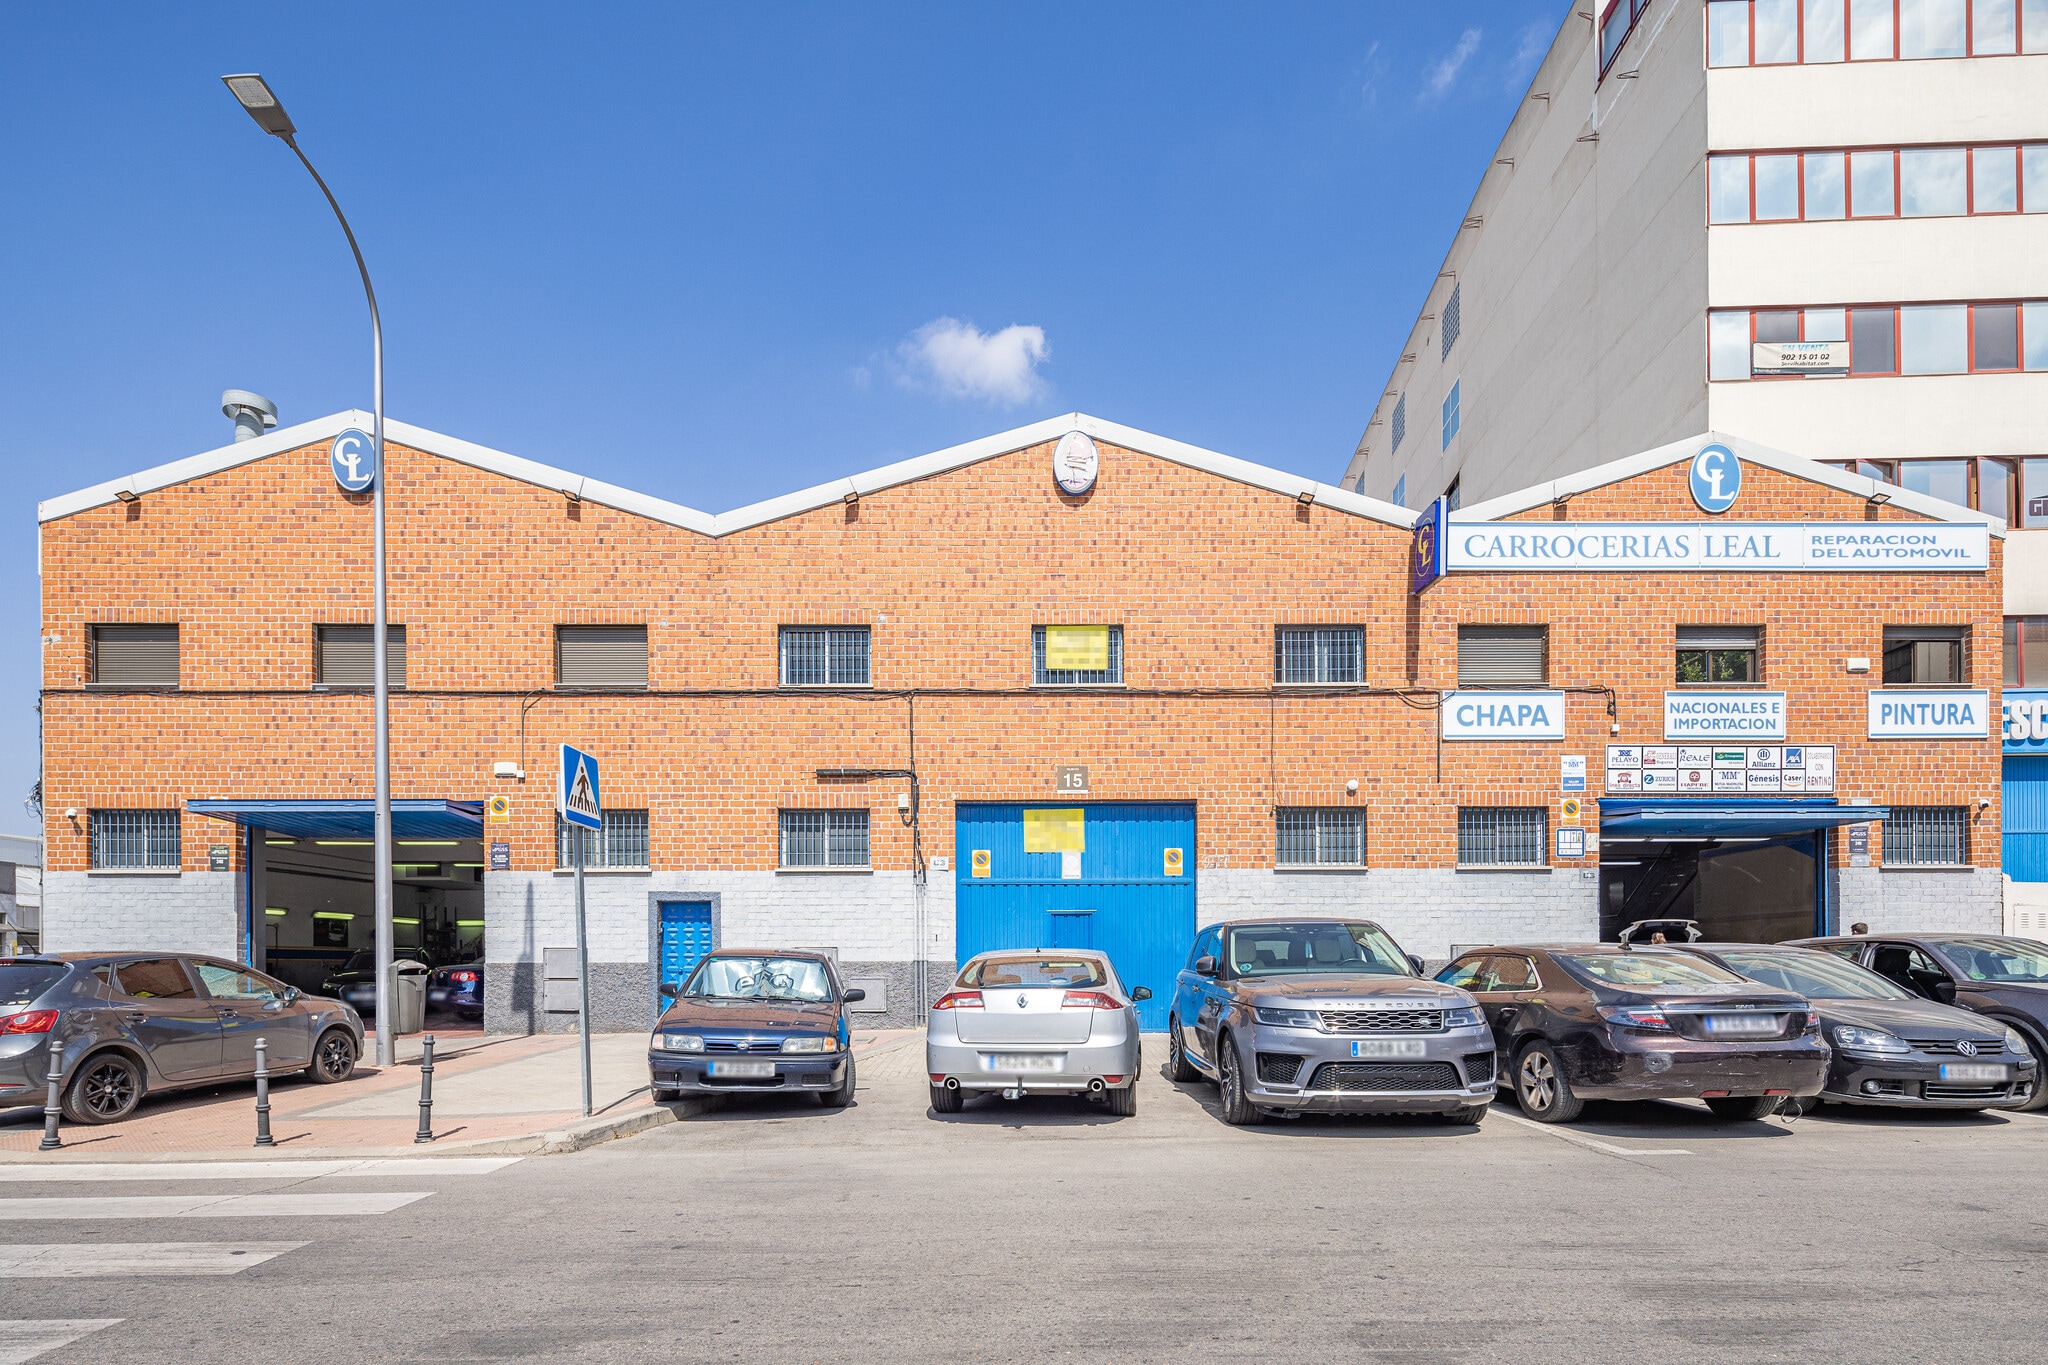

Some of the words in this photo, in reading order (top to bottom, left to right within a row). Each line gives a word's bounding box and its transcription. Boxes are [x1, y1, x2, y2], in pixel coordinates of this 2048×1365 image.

[1464, 534, 1690, 558] CARROCERIAS
[1704, 535, 1780, 558] LEAL
[1811, 535, 1936, 545] REPARACION
[1811, 549, 1849, 558] DEL
[1852, 549, 1971, 558] AUTOMOVIL
[1669, 702, 1767, 715] NACIONALES
[1771, 703, 1780, 714] E
[1881, 703, 1975, 726] PINTURA
[1456, 704, 1550, 727] CHAPA
[1673, 718, 1777, 730] IMPORTACION
[1815, 763, 1824, 771] CON
[1063, 773, 1083, 788] 15
[1748, 775, 1780, 783] Génesis
[1807, 776, 1832, 786] RENTING
